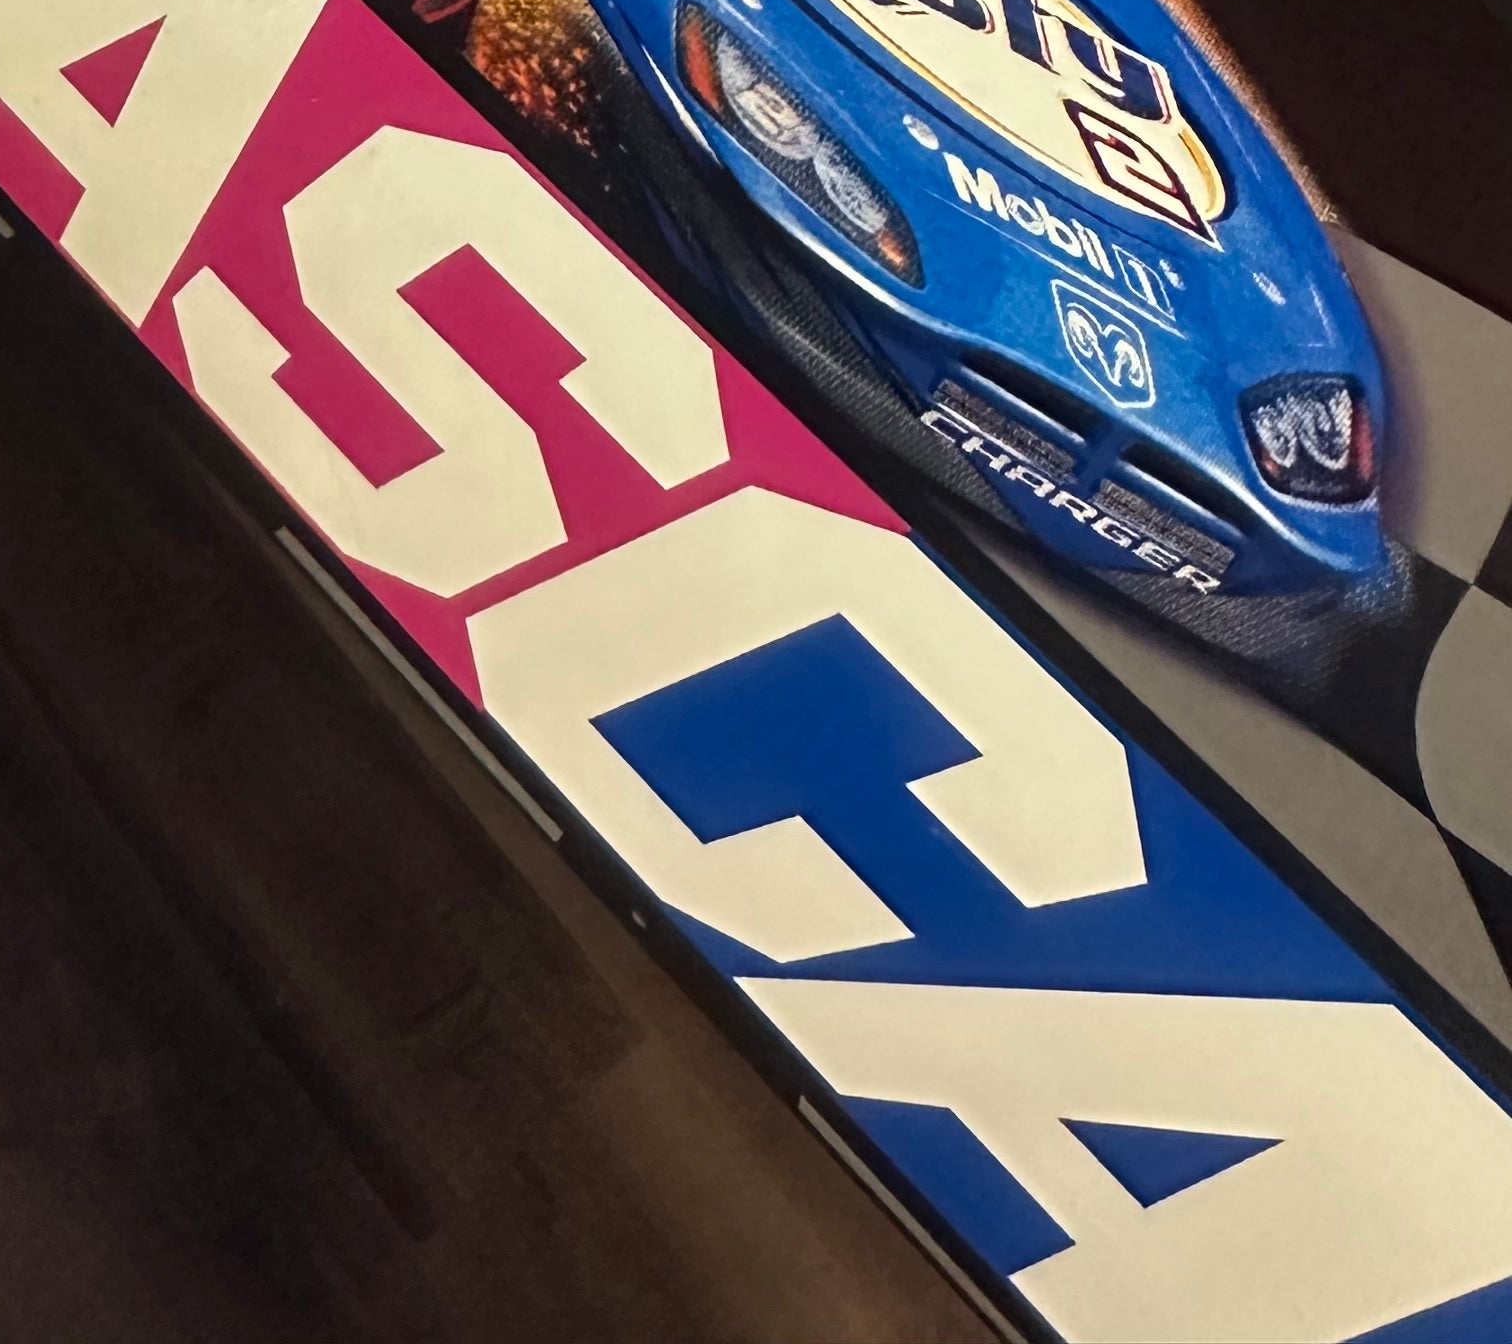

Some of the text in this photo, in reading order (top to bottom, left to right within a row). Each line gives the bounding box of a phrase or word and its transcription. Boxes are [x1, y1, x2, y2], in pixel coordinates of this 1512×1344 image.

[942, 151, 1115, 280] Mobil
[1070, 104, 1210, 238] 2
[920, 409, 1221, 596] CHARGER
